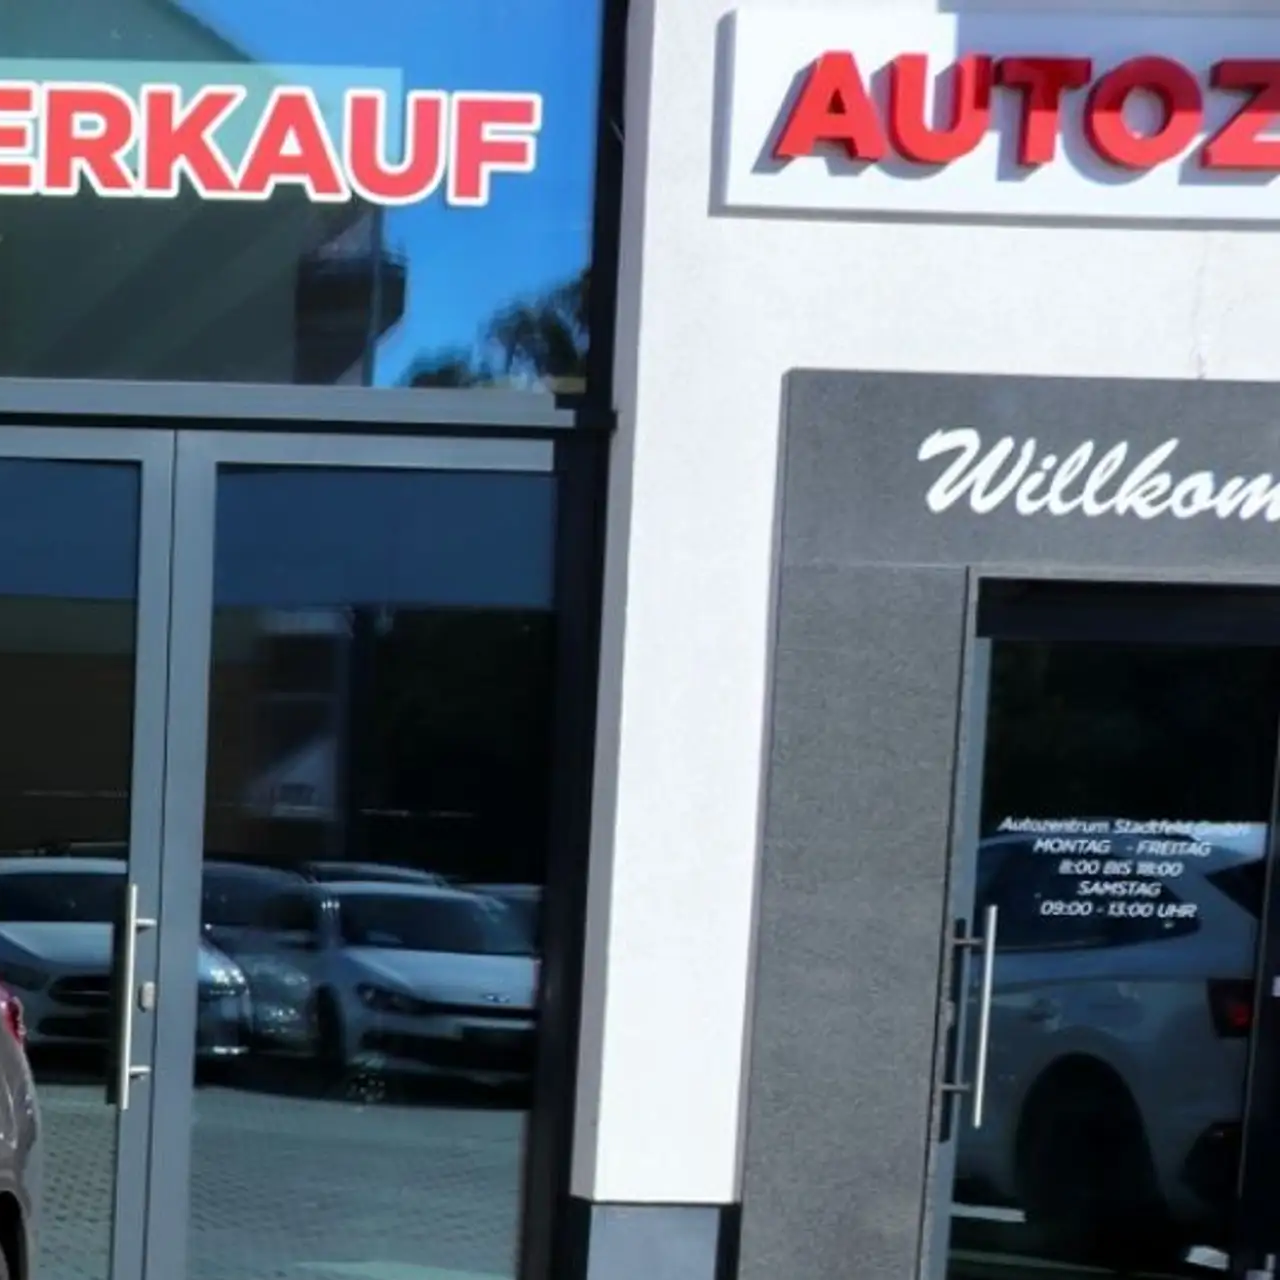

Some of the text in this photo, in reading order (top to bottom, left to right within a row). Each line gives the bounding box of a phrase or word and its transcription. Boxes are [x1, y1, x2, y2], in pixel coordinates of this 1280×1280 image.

[772, 51, 1280, 171] AUTOZ
[917, 428, 1280, 522] Willkom
[1033, 838, 1112, 855] MONTAG
[1136, 840, 1212, 857] FREITAG
[1076, 880, 1162, 897] SAMSTAG
[1157, 903, 1199, 919] UHR
